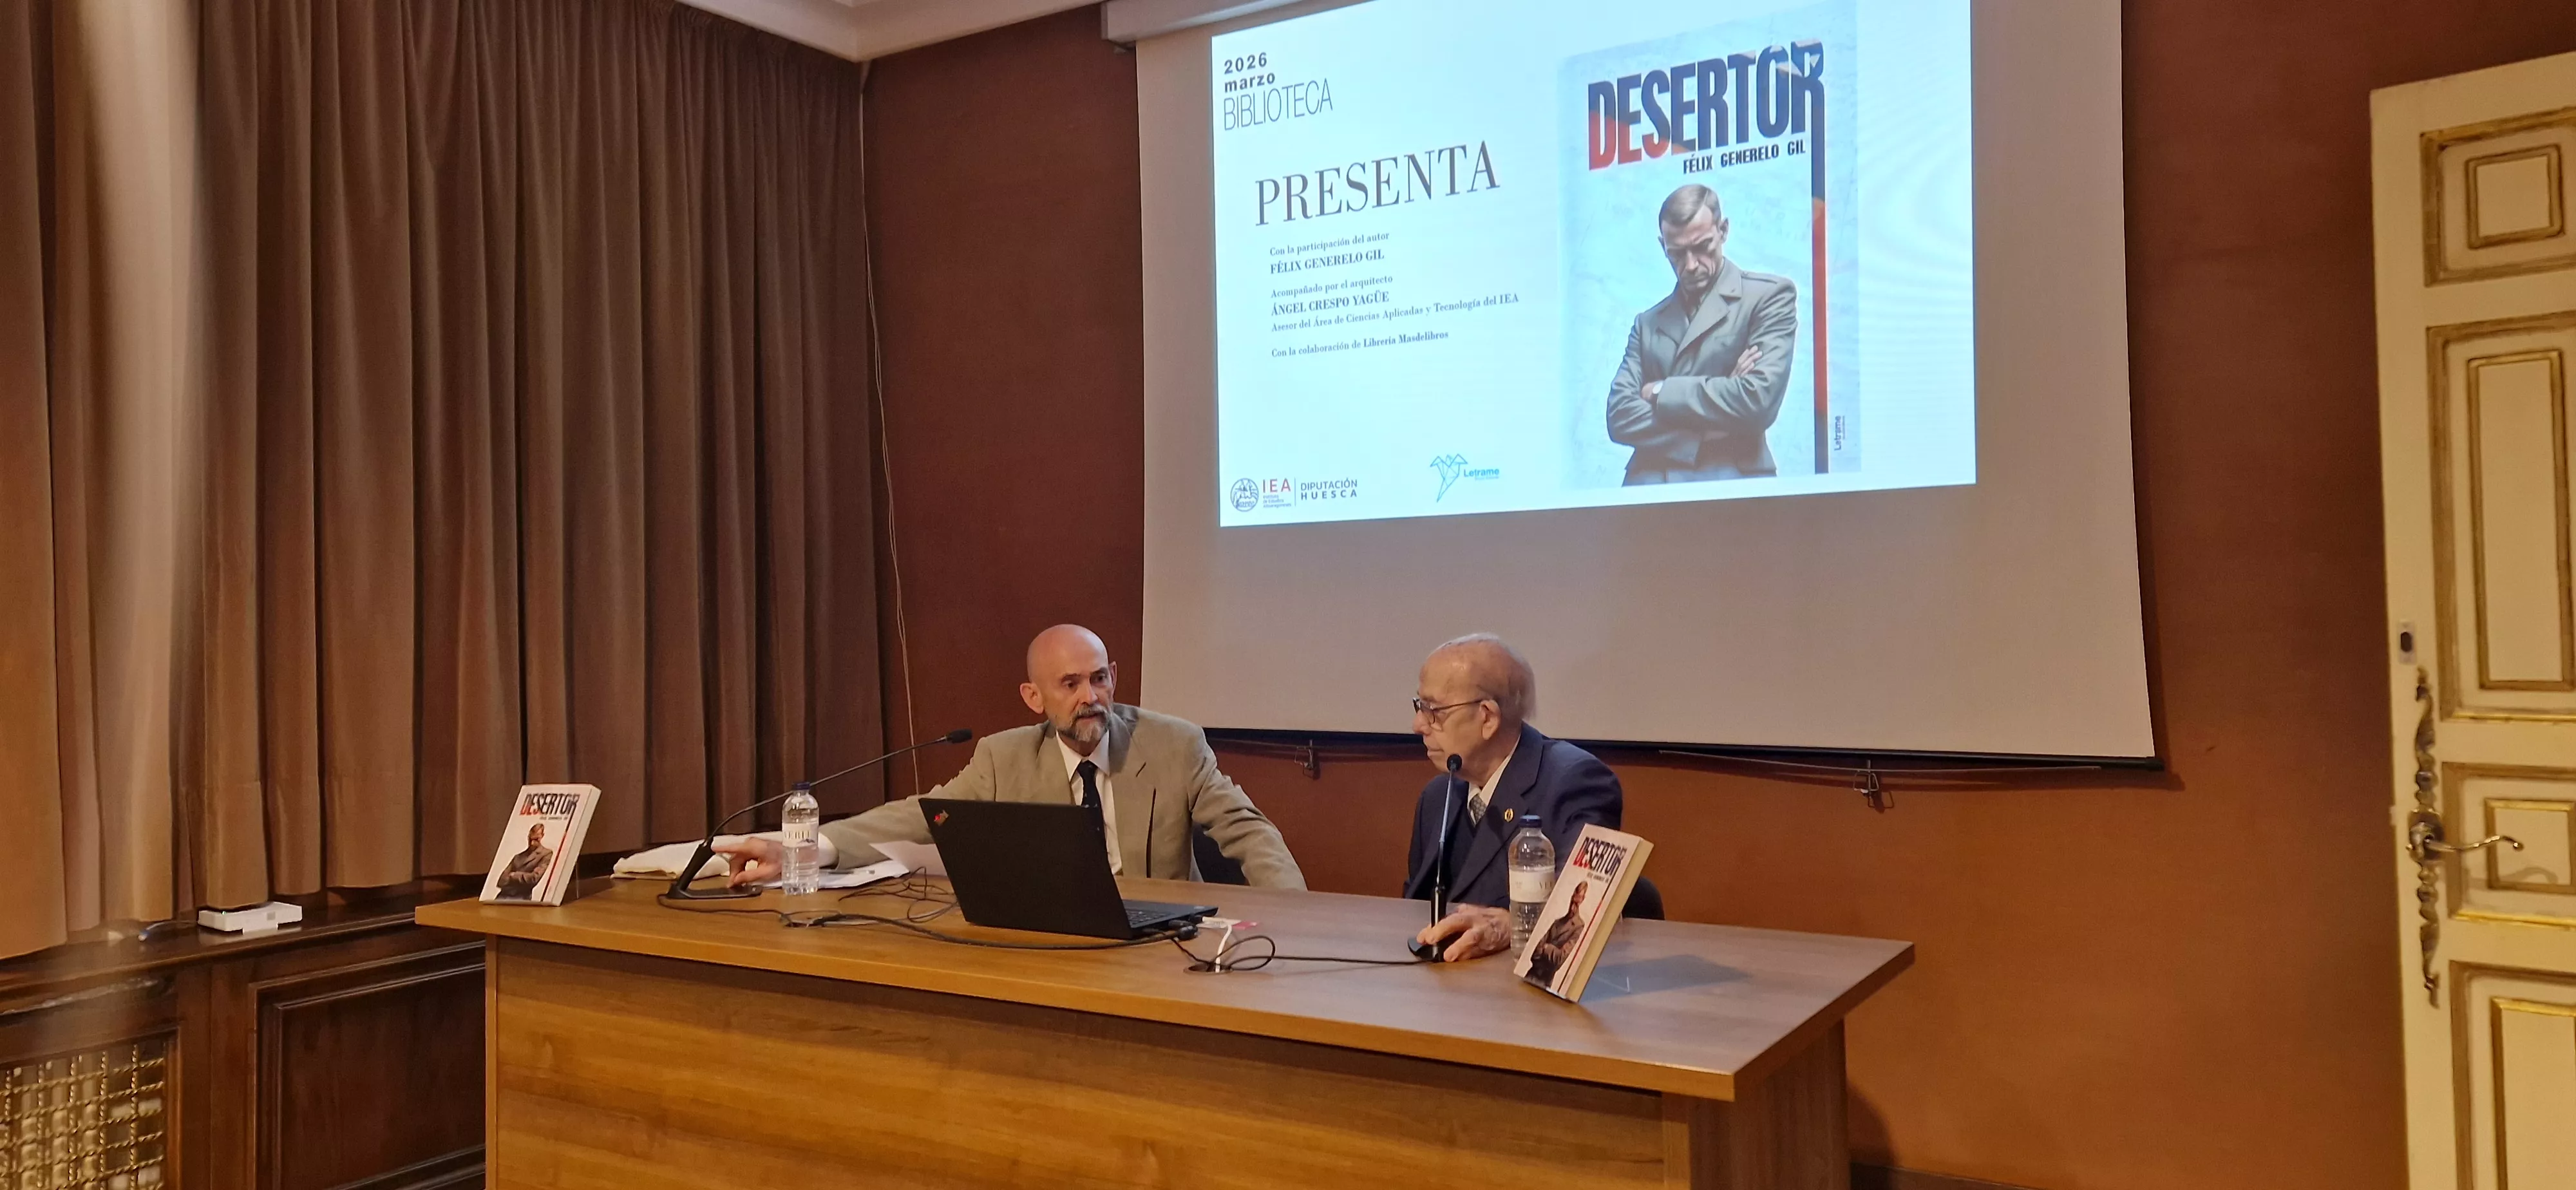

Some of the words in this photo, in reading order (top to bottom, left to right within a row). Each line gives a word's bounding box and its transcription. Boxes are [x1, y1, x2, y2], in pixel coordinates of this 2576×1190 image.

[1224, 52, 1267, 75] 2026
[1224, 72, 1275, 93] marzo
[1224, 78, 1333, 131] BIBLIOTECA
[1588, 38, 1824, 171] DESERTOR
[1683, 154, 1712, 175] FÉLIX
[1720, 144, 1779, 168] GENERELO
[1787, 139, 1806, 155] GIL
[1255, 140, 1501, 227] PRESENTA
[1270, 247, 1285, 256] Con
[1287, 245, 1294, 254] la
[1297, 238, 1350, 256] participación
[1352, 234, 1365, 245] del
[1367, 232, 1390, 243] autor
[1270, 260, 1302, 275] FÉLIX
[1305, 252, 1363, 270] GENERELO
[1365, 249, 1385, 261] GIL
[1271, 283, 1323, 299] Acompañado
[1325, 283, 1339, 294] por
[1341, 279, 1348, 289] el
[1350, 275, 1393, 290] arquitecto
[1271, 302, 1307, 316] ÁNGEL
[1309, 296, 1350, 312] CRESPO
[1352, 290, 1390, 307] YAGÜE
[1272, 322, 1298, 332] Asesor
[1299, 319, 1311, 329] del
[1313, 315, 1332, 327] Área
[1335, 315, 1344, 325] de
[1346, 312, 1380, 323] Ciencias
[1383, 306, 1423, 321] Aplicadas
[1426, 306, 1432, 316] y
[1434, 298, 1481, 312] Tecnología
[1483, 296, 1497, 307] del
[1499, 292, 1519, 305] IEA
[1272, 348, 1287, 358] Con
[1289, 346, 1296, 356] la
[1298, 341, 1350, 355] colaboración
[1352, 339, 1361, 349] de
[1363, 336, 1396, 348] Librería
[1399, 330, 1449, 345] Masdelibros
[1262, 478, 1291, 493] IEA
[1301, 477, 1358, 491] DIPUTACIÓN
[1464, 468, 1499, 478] Letrame
[1301, 489, 1358, 501] HUESCA
[520, 793, 581, 816] DESERTOR
[1573, 836, 1628, 876] DESERTOR
